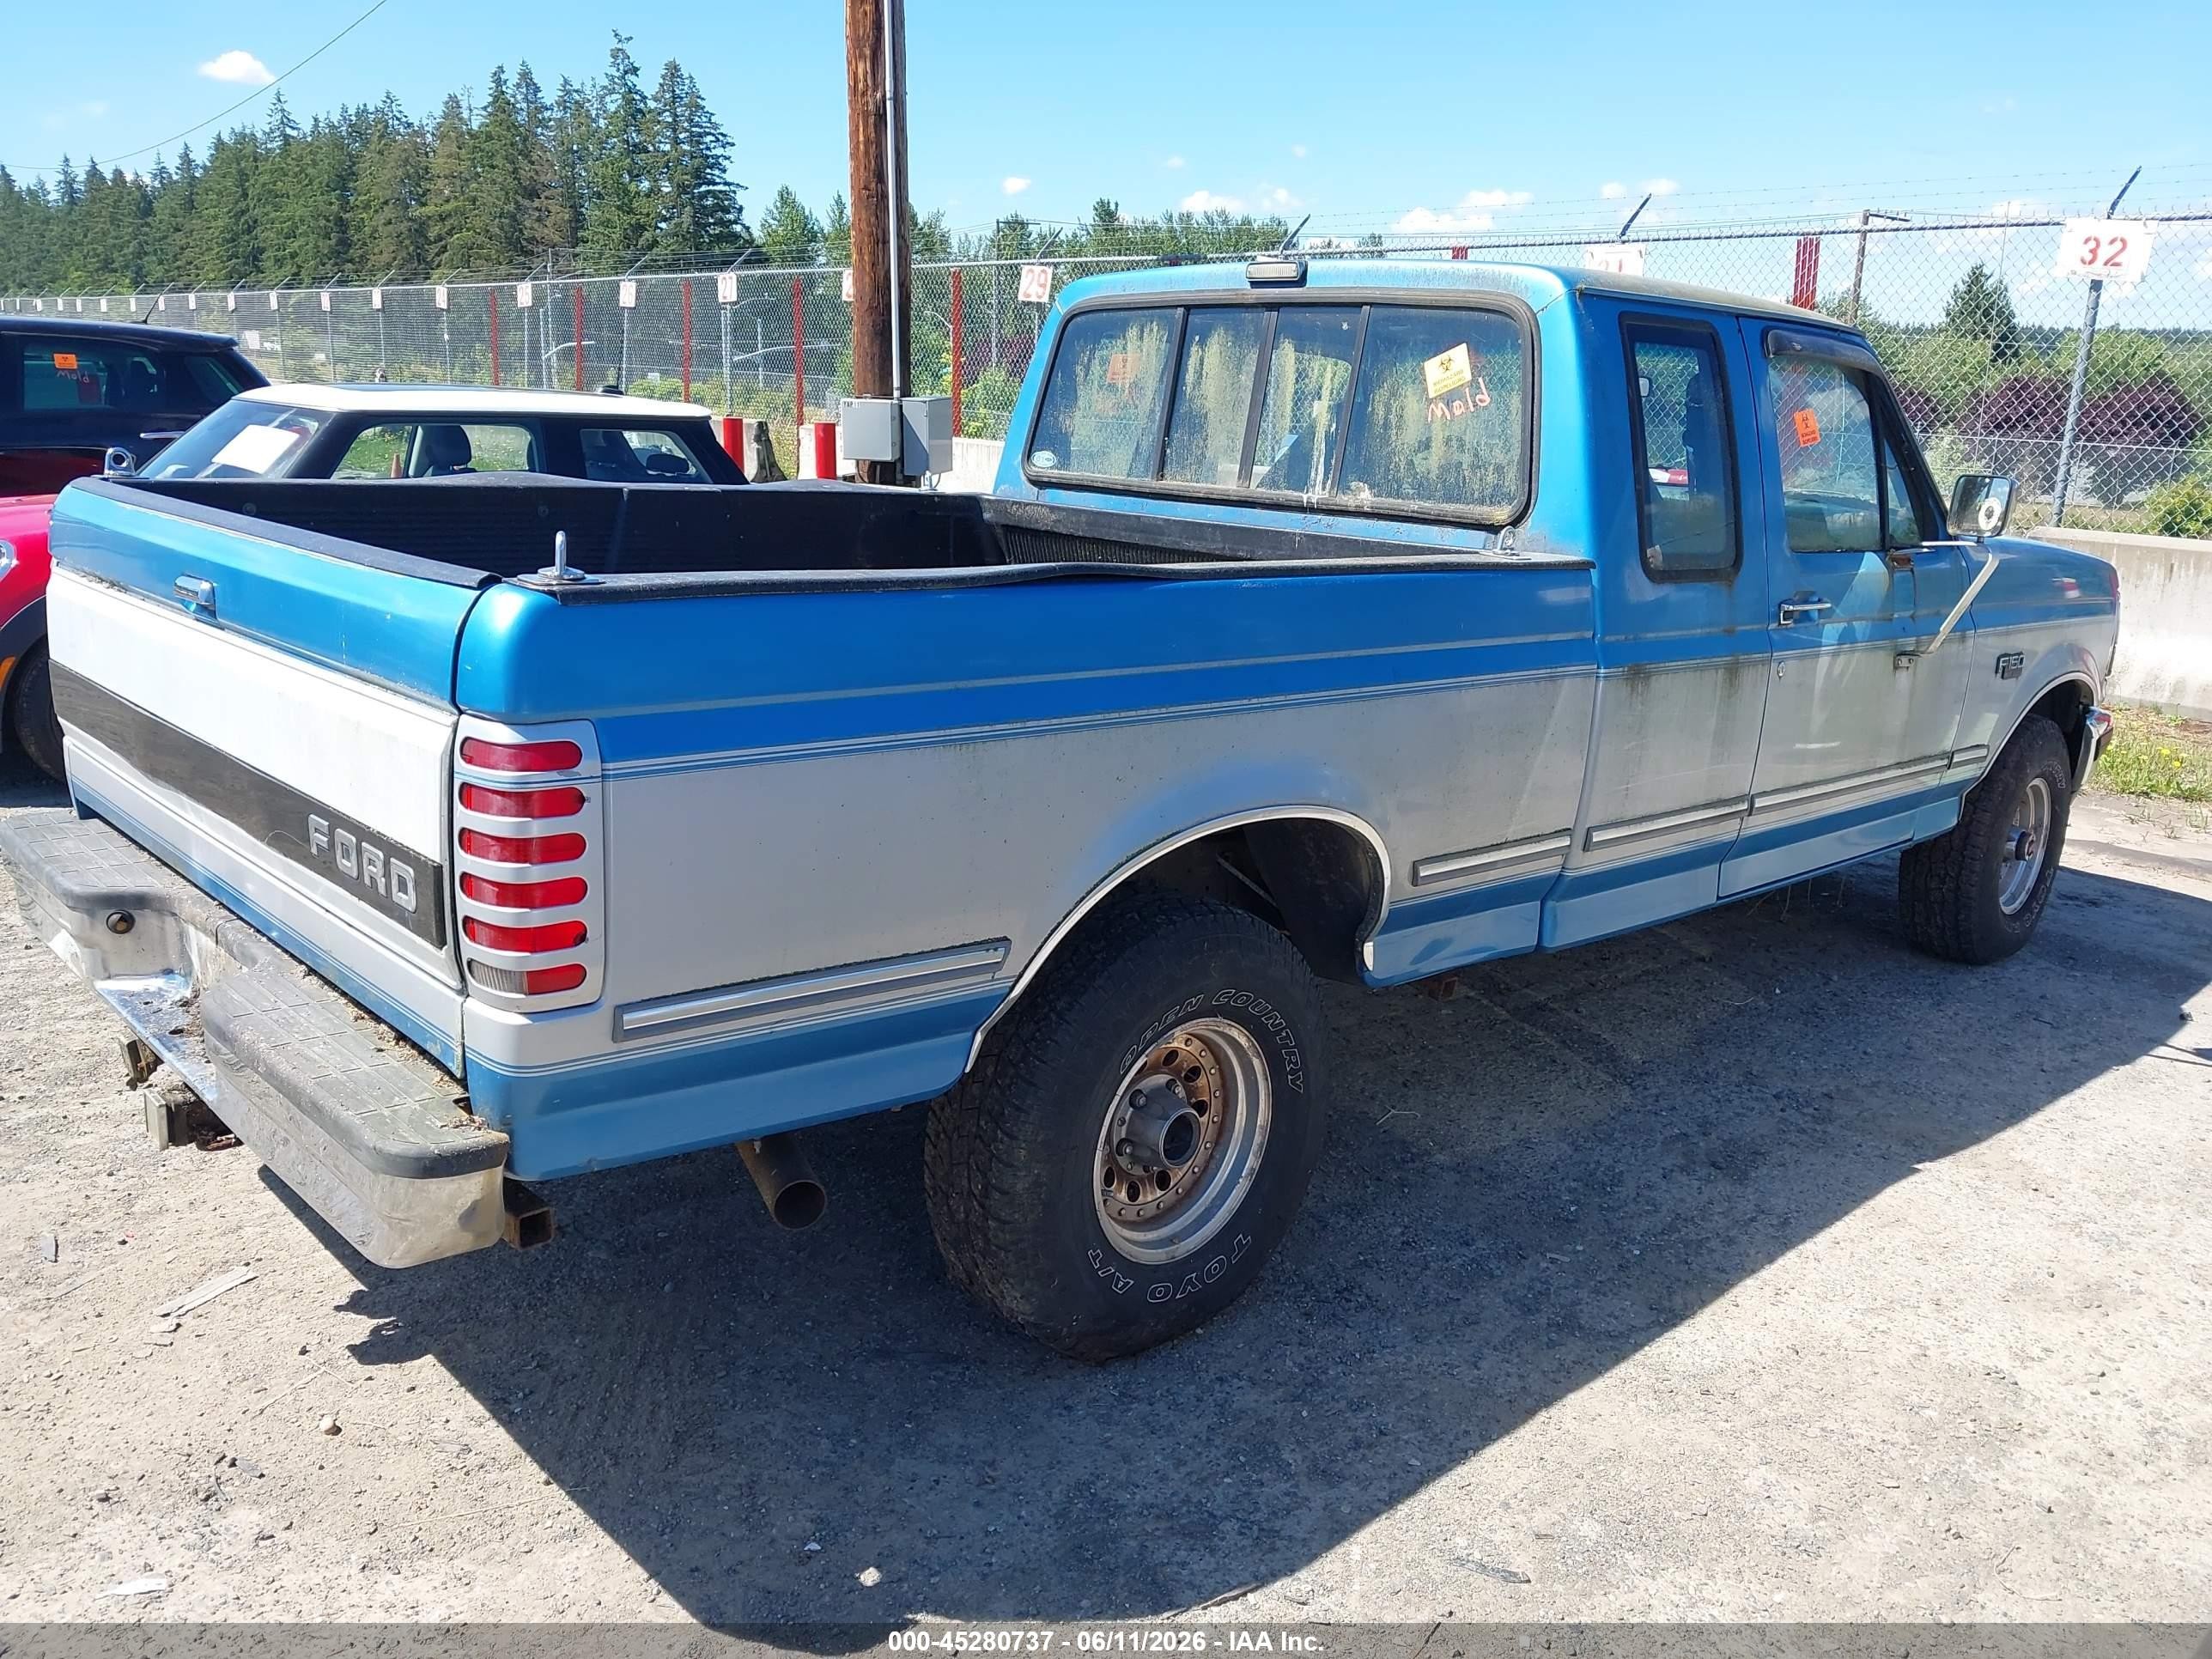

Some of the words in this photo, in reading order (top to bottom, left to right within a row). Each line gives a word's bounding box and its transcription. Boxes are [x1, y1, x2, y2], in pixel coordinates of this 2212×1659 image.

[2079, 234, 2129, 267] 32
[720, 276, 734, 300] 27
[1023, 267, 1048, 299] 29
[1427, 376, 1491, 423] Mold
[307, 813, 417, 915] FORD
[1120, 994, 1204, 1075] OPEN
[1212, 988, 1304, 1094] COUNTRY
[1087, 1249, 1134, 1294] A/T
[1146, 1233, 1252, 1304] TOYO
